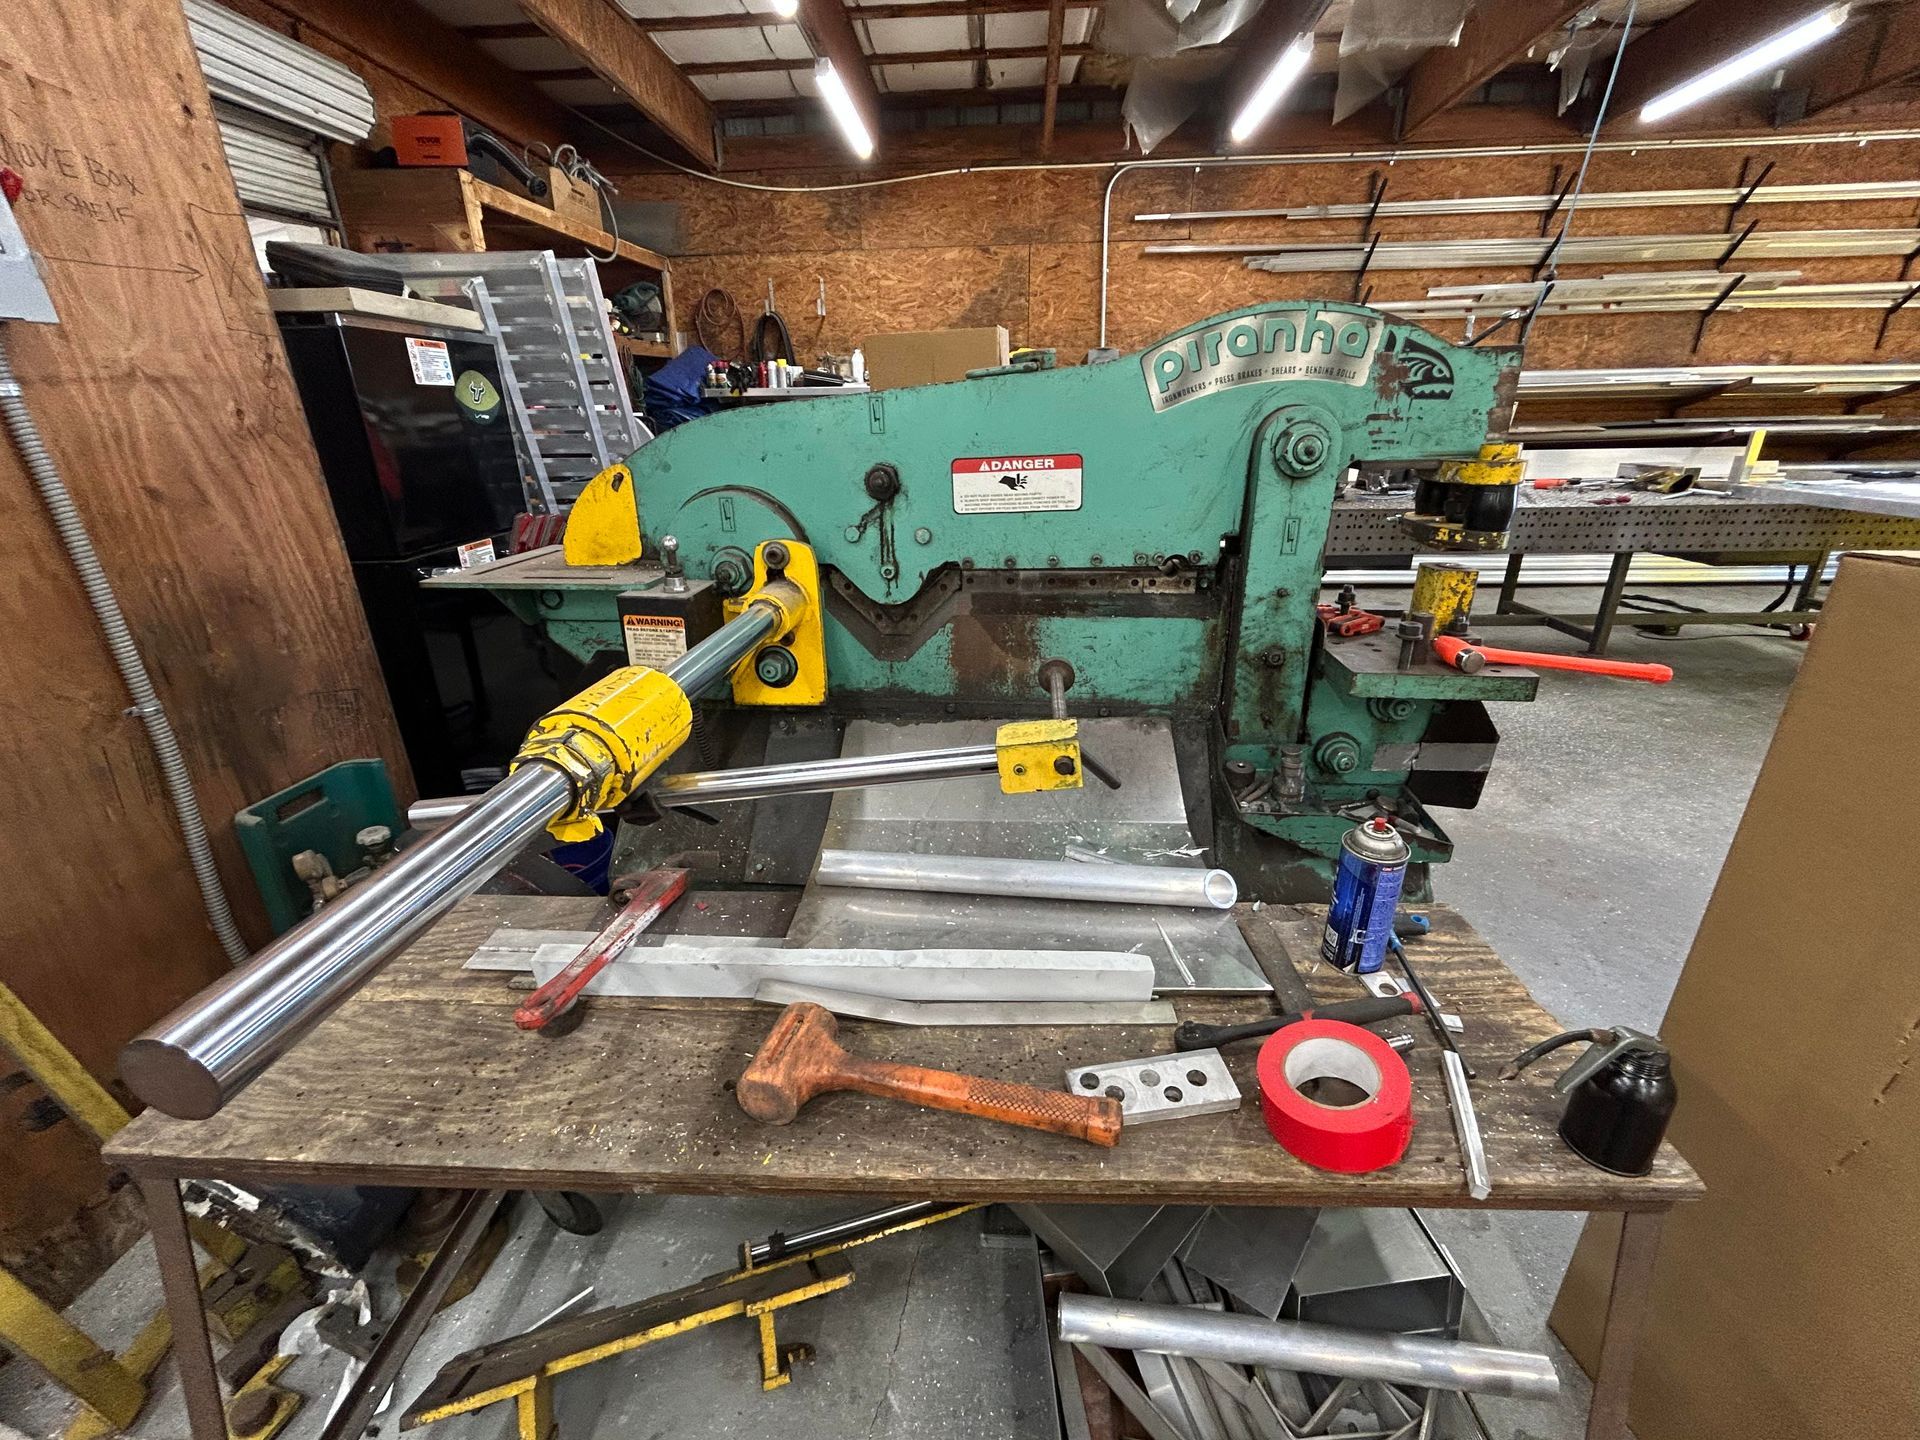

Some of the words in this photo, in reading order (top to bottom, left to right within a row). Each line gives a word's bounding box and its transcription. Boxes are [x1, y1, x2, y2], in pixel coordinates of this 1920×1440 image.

[1153, 308, 1371, 393] piranha
[1161, 381, 1207, 405] IRONWORKERS
[1214, 374, 1235, 386] PRESS
[1237, 368, 1263, 380] BRAKES
[1271, 366, 1297, 376] SHEARS
[1305, 365, 1335, 376] BENDING
[991, 458, 1055, 471] DANGER
[636, 617, 683, 627] WARNING!
